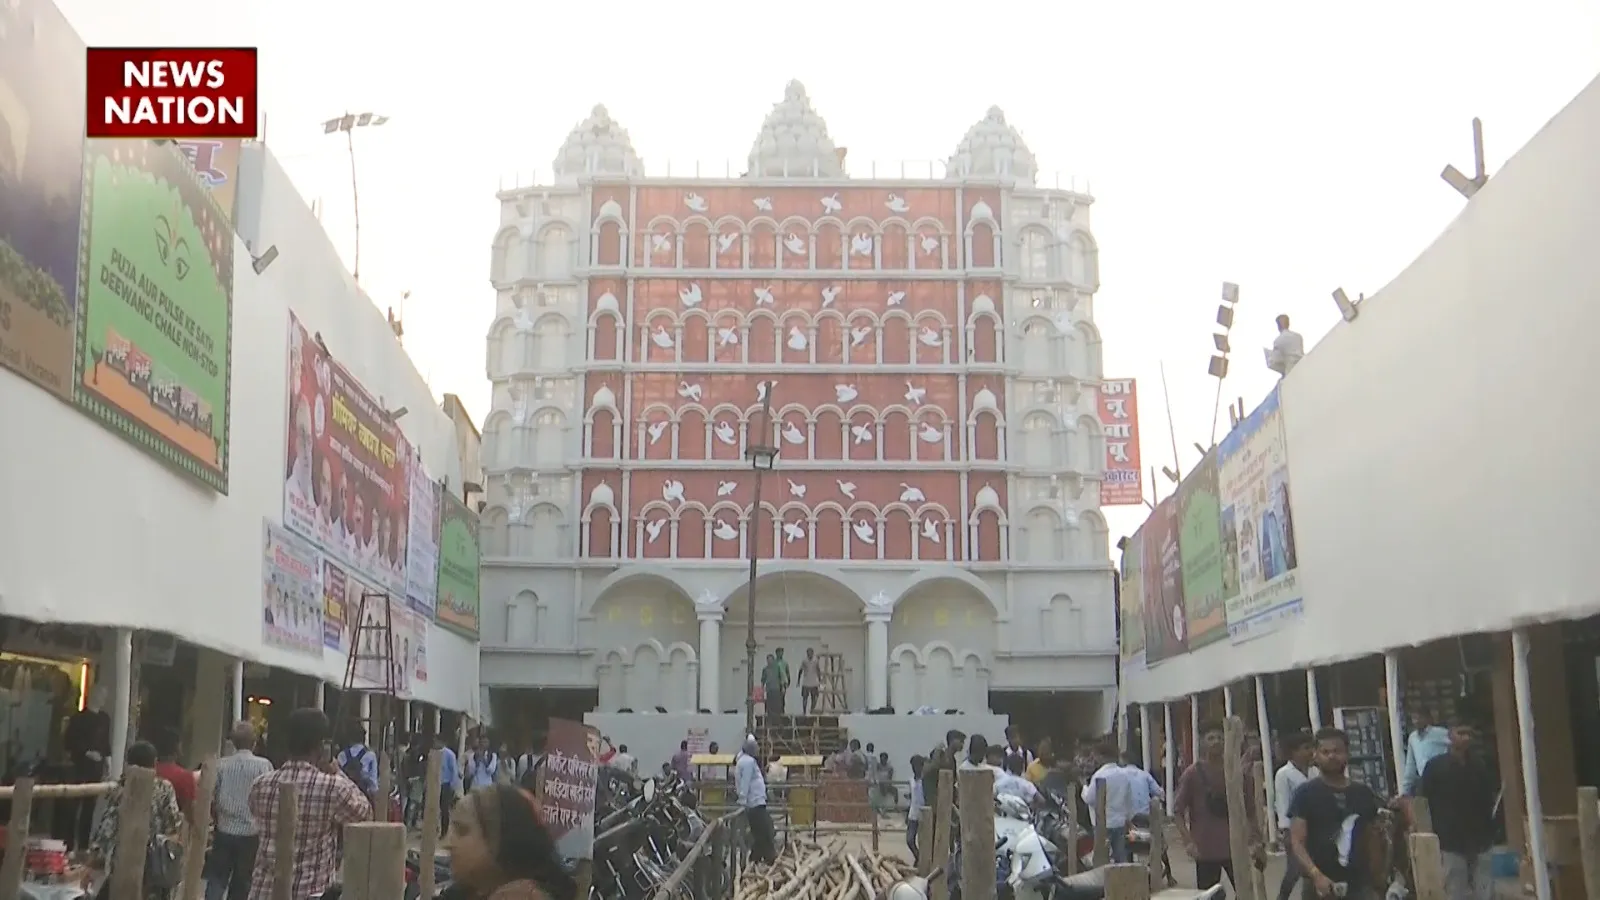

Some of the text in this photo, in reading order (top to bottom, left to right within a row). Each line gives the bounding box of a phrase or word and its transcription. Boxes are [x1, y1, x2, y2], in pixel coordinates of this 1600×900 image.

[100, 264, 154, 324] DEEWANGI
[155, 312, 182, 346] CHALE
[110, 247, 136, 284] PUJA
[138, 273, 158, 302] AUR
[159, 291, 184, 325] PULSE
[185, 316, 195, 336] KE
